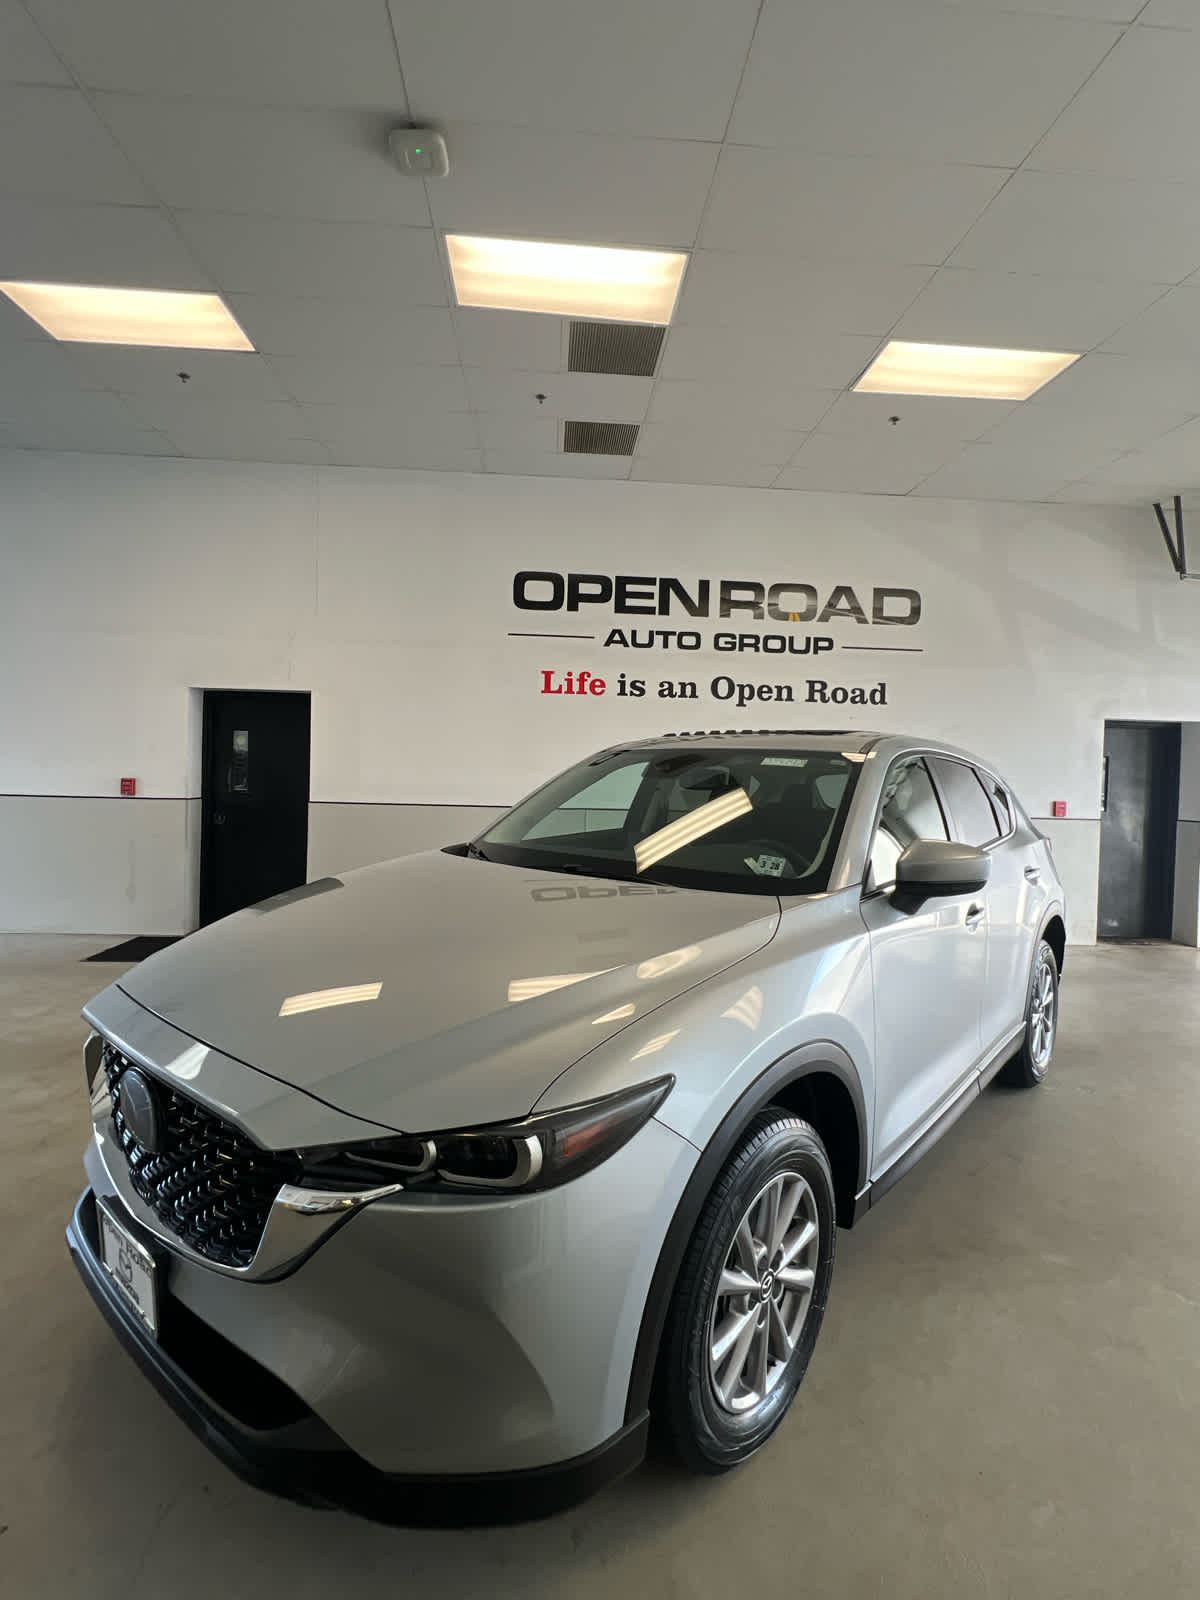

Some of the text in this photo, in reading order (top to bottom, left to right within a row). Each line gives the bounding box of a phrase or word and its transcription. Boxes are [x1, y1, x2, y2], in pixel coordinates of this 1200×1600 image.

[603, 629, 834, 655] AUTO GROUP
[541, 670, 887, 707] Life is an Open Road
